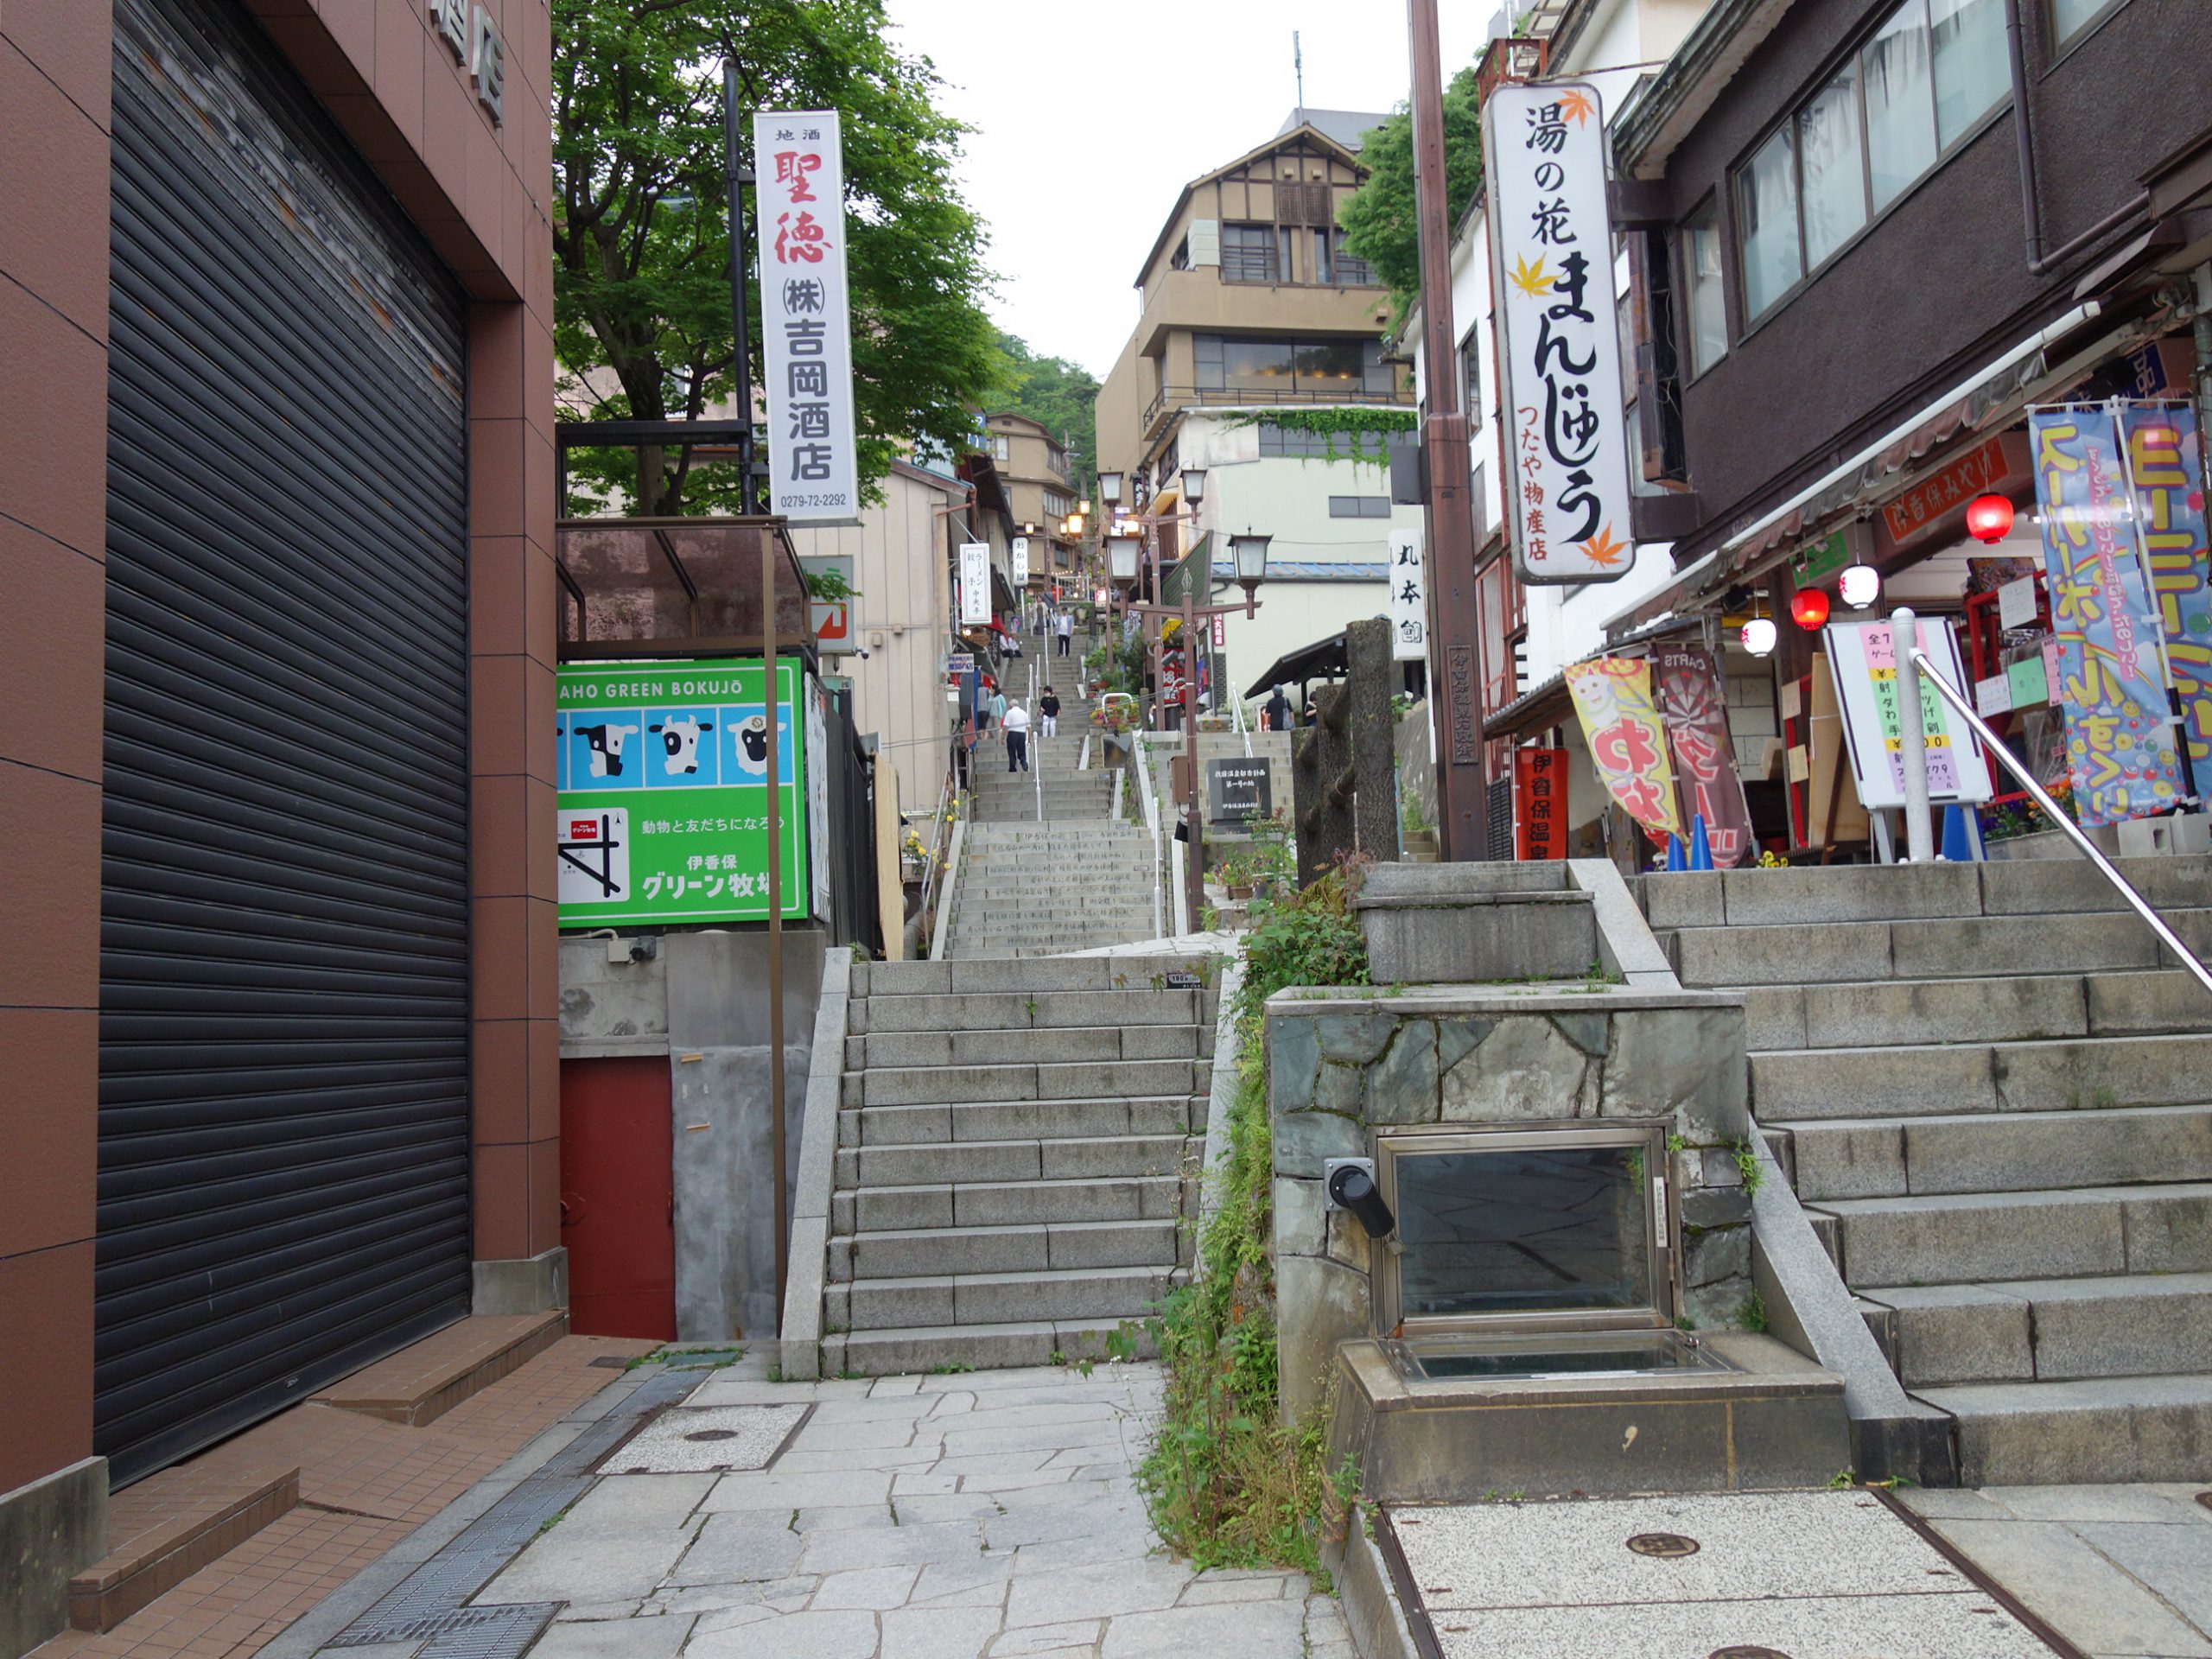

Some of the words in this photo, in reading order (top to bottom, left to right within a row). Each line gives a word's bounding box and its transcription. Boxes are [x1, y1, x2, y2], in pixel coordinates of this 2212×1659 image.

[775, 129, 821, 141] 地酒
[774, 150, 834, 264] 聖徳
[1517, 406, 1548, 563] つたや物産店
[1892, 440, 1994, 530] 伊香保みやげ
[781, 493, 846, 508] 0279-72-2292
[605, 683, 664, 698] GREEN
[1885, 706, 1935, 721] わげ
[1889, 721, 1940, 736] 手剣
[1893, 736, 1942, 750] ¥00
[1530, 753, 1552, 860] 伊香保温泉
[687, 854, 738, 871] 伊香保
